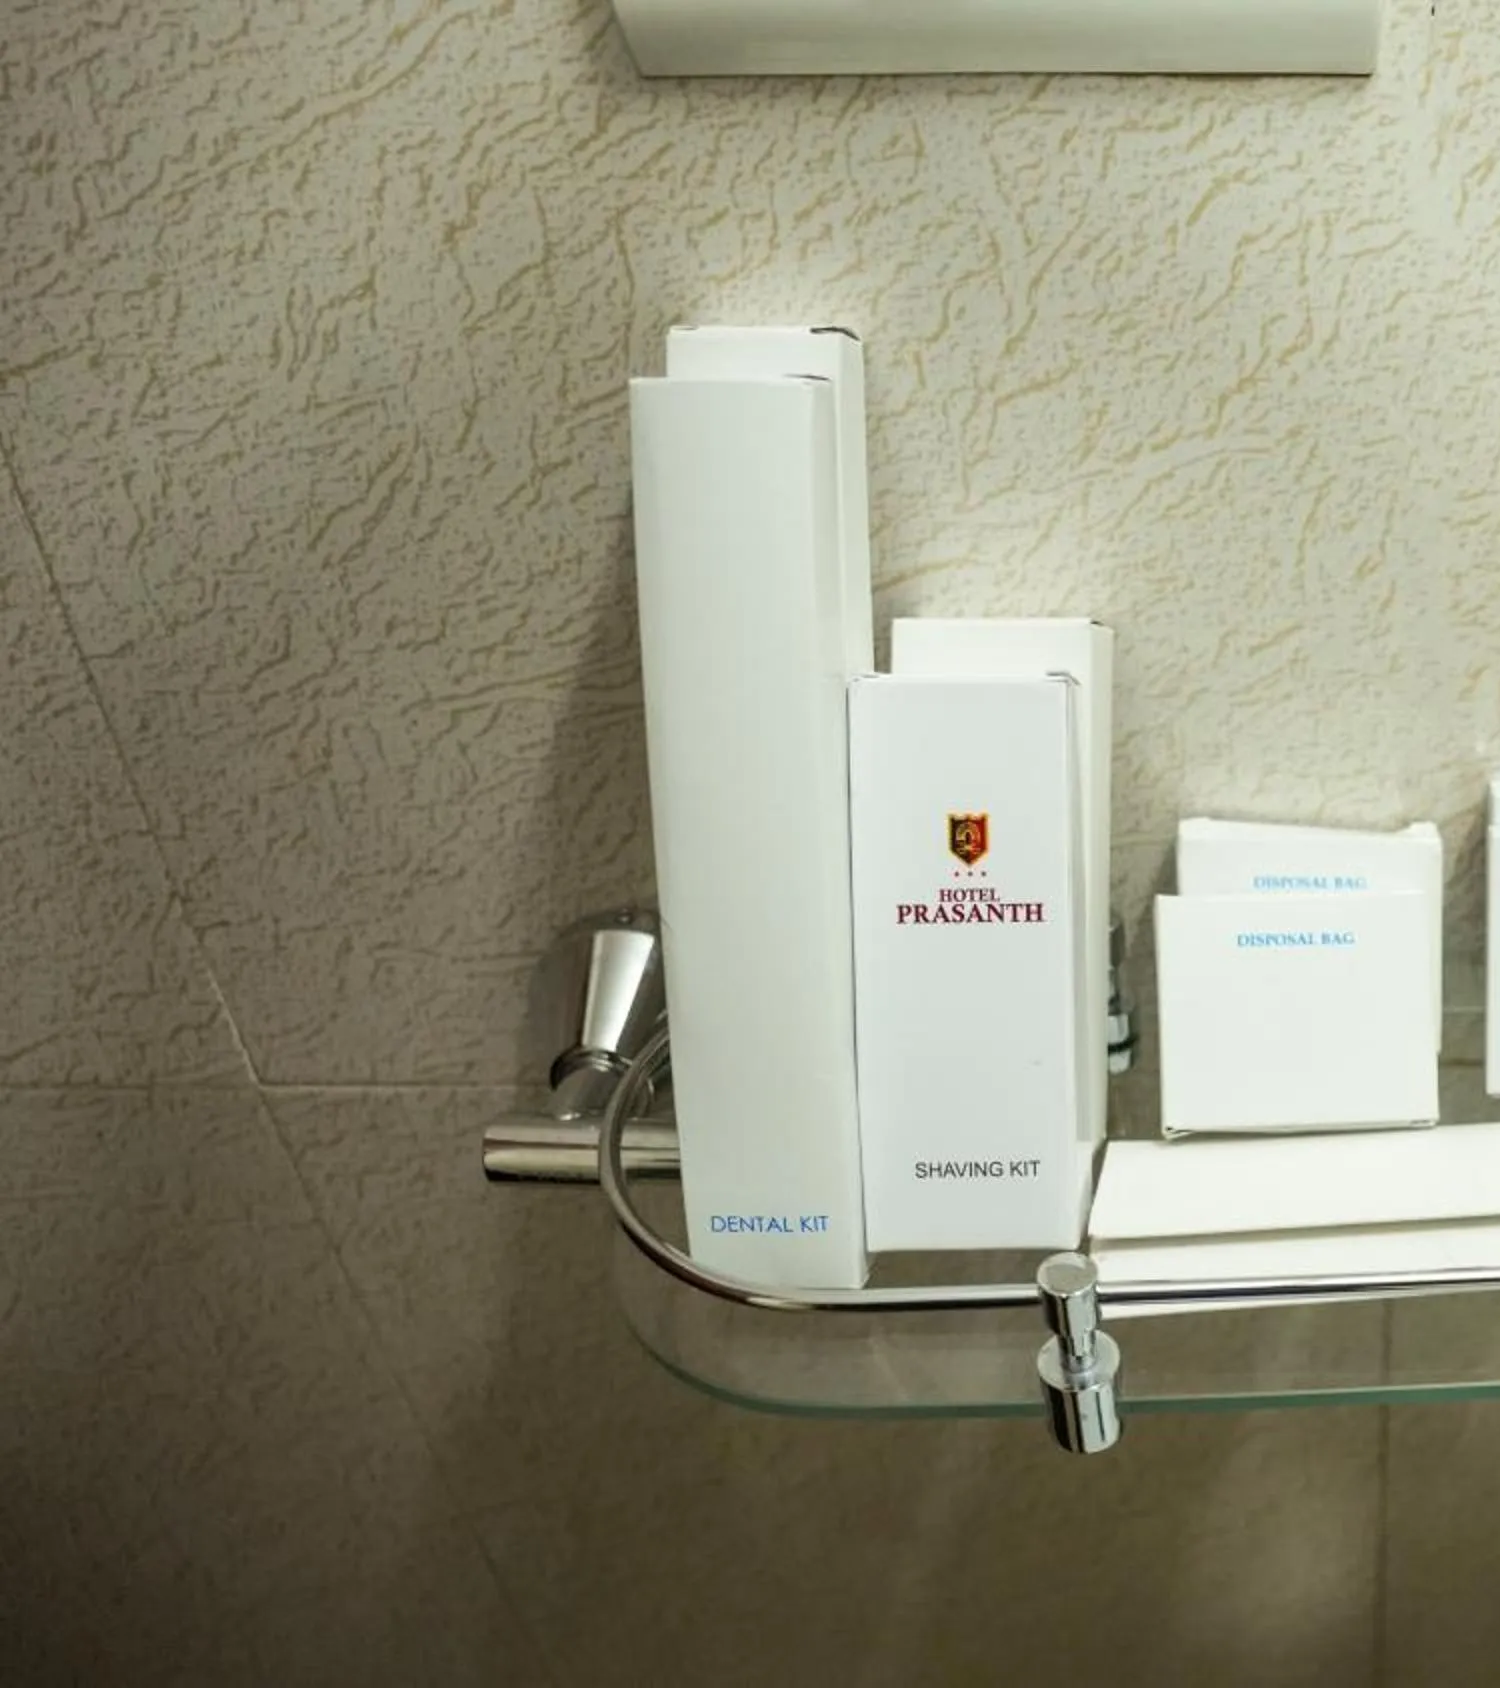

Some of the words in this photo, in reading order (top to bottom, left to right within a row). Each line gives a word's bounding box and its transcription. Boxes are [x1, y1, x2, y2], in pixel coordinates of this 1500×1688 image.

[1253, 875, 1328, 890] DISPOSAL
[1334, 875, 1367, 889] BAG
[938, 887, 1001, 903] HOTEL
[896, 902, 1045, 925] PRASANTH
[1236, 932, 1314, 947] DISPOSAL
[1321, 931, 1356, 945] BAG
[914, 1160, 1004, 1179] SHAVING
[1009, 1159, 1041, 1177] KIT
[710, 1215, 794, 1233] DENTAL
[799, 1214, 830, 1232] KIT
